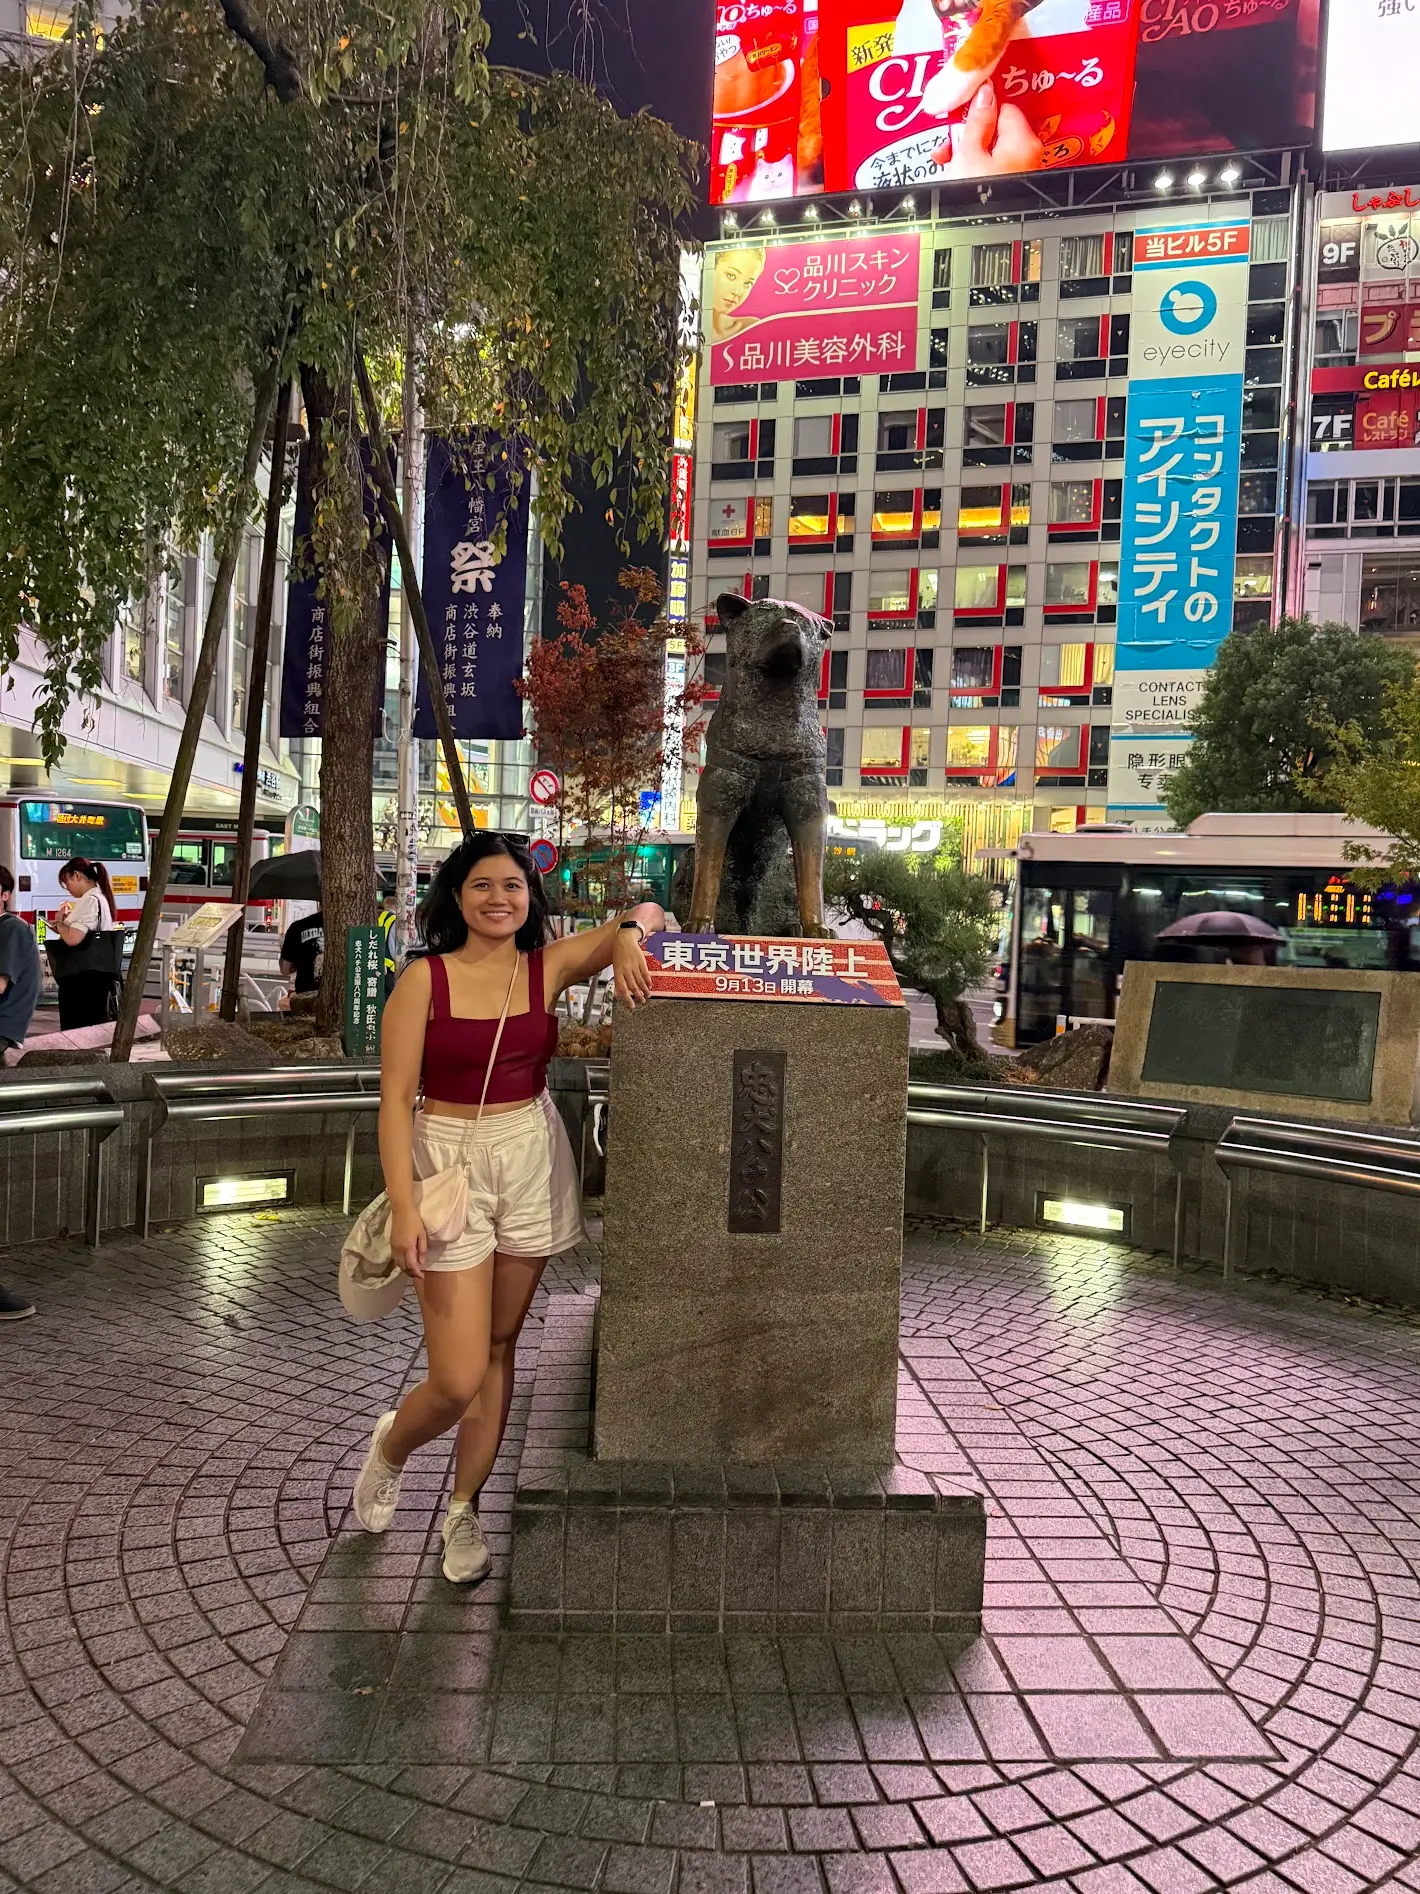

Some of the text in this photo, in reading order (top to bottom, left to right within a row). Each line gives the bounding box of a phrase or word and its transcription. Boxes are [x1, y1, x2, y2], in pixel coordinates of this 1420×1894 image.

[1145, 230, 1238, 258] 当ビル5F
[1322, 242, 1356, 265] 9F
[803, 248, 909, 279] 品川スキン
[803, 274, 897, 301] クリニック
[740, 330, 906, 371] 品川美容外科
[1143, 338, 1231, 366] eyecity
[1312, 414, 1352, 440] 7F
[1363, 411, 1409, 430] Café
[1364, 430, 1408, 442] レストラン
[1134, 417, 1184, 623] アイシティ
[1184, 415, 1225, 623] コンタクトの
[451, 541, 496, 593] 祭
[486, 602, 503, 639] 奉納
[460, 603, 479, 698] 渋谷道玄坂
[302, 606, 326, 734] 商店街振興組合
[443, 604, 458, 730] 商店街振興組
[1139, 681, 1202, 693] CONTACT
[1153, 695, 1187, 706] LENS
[55, 848, 71, 857] 1264
[661, 941, 869, 978] 東京世界陸上
[715, 976, 814, 995] 9月13日 開幕
